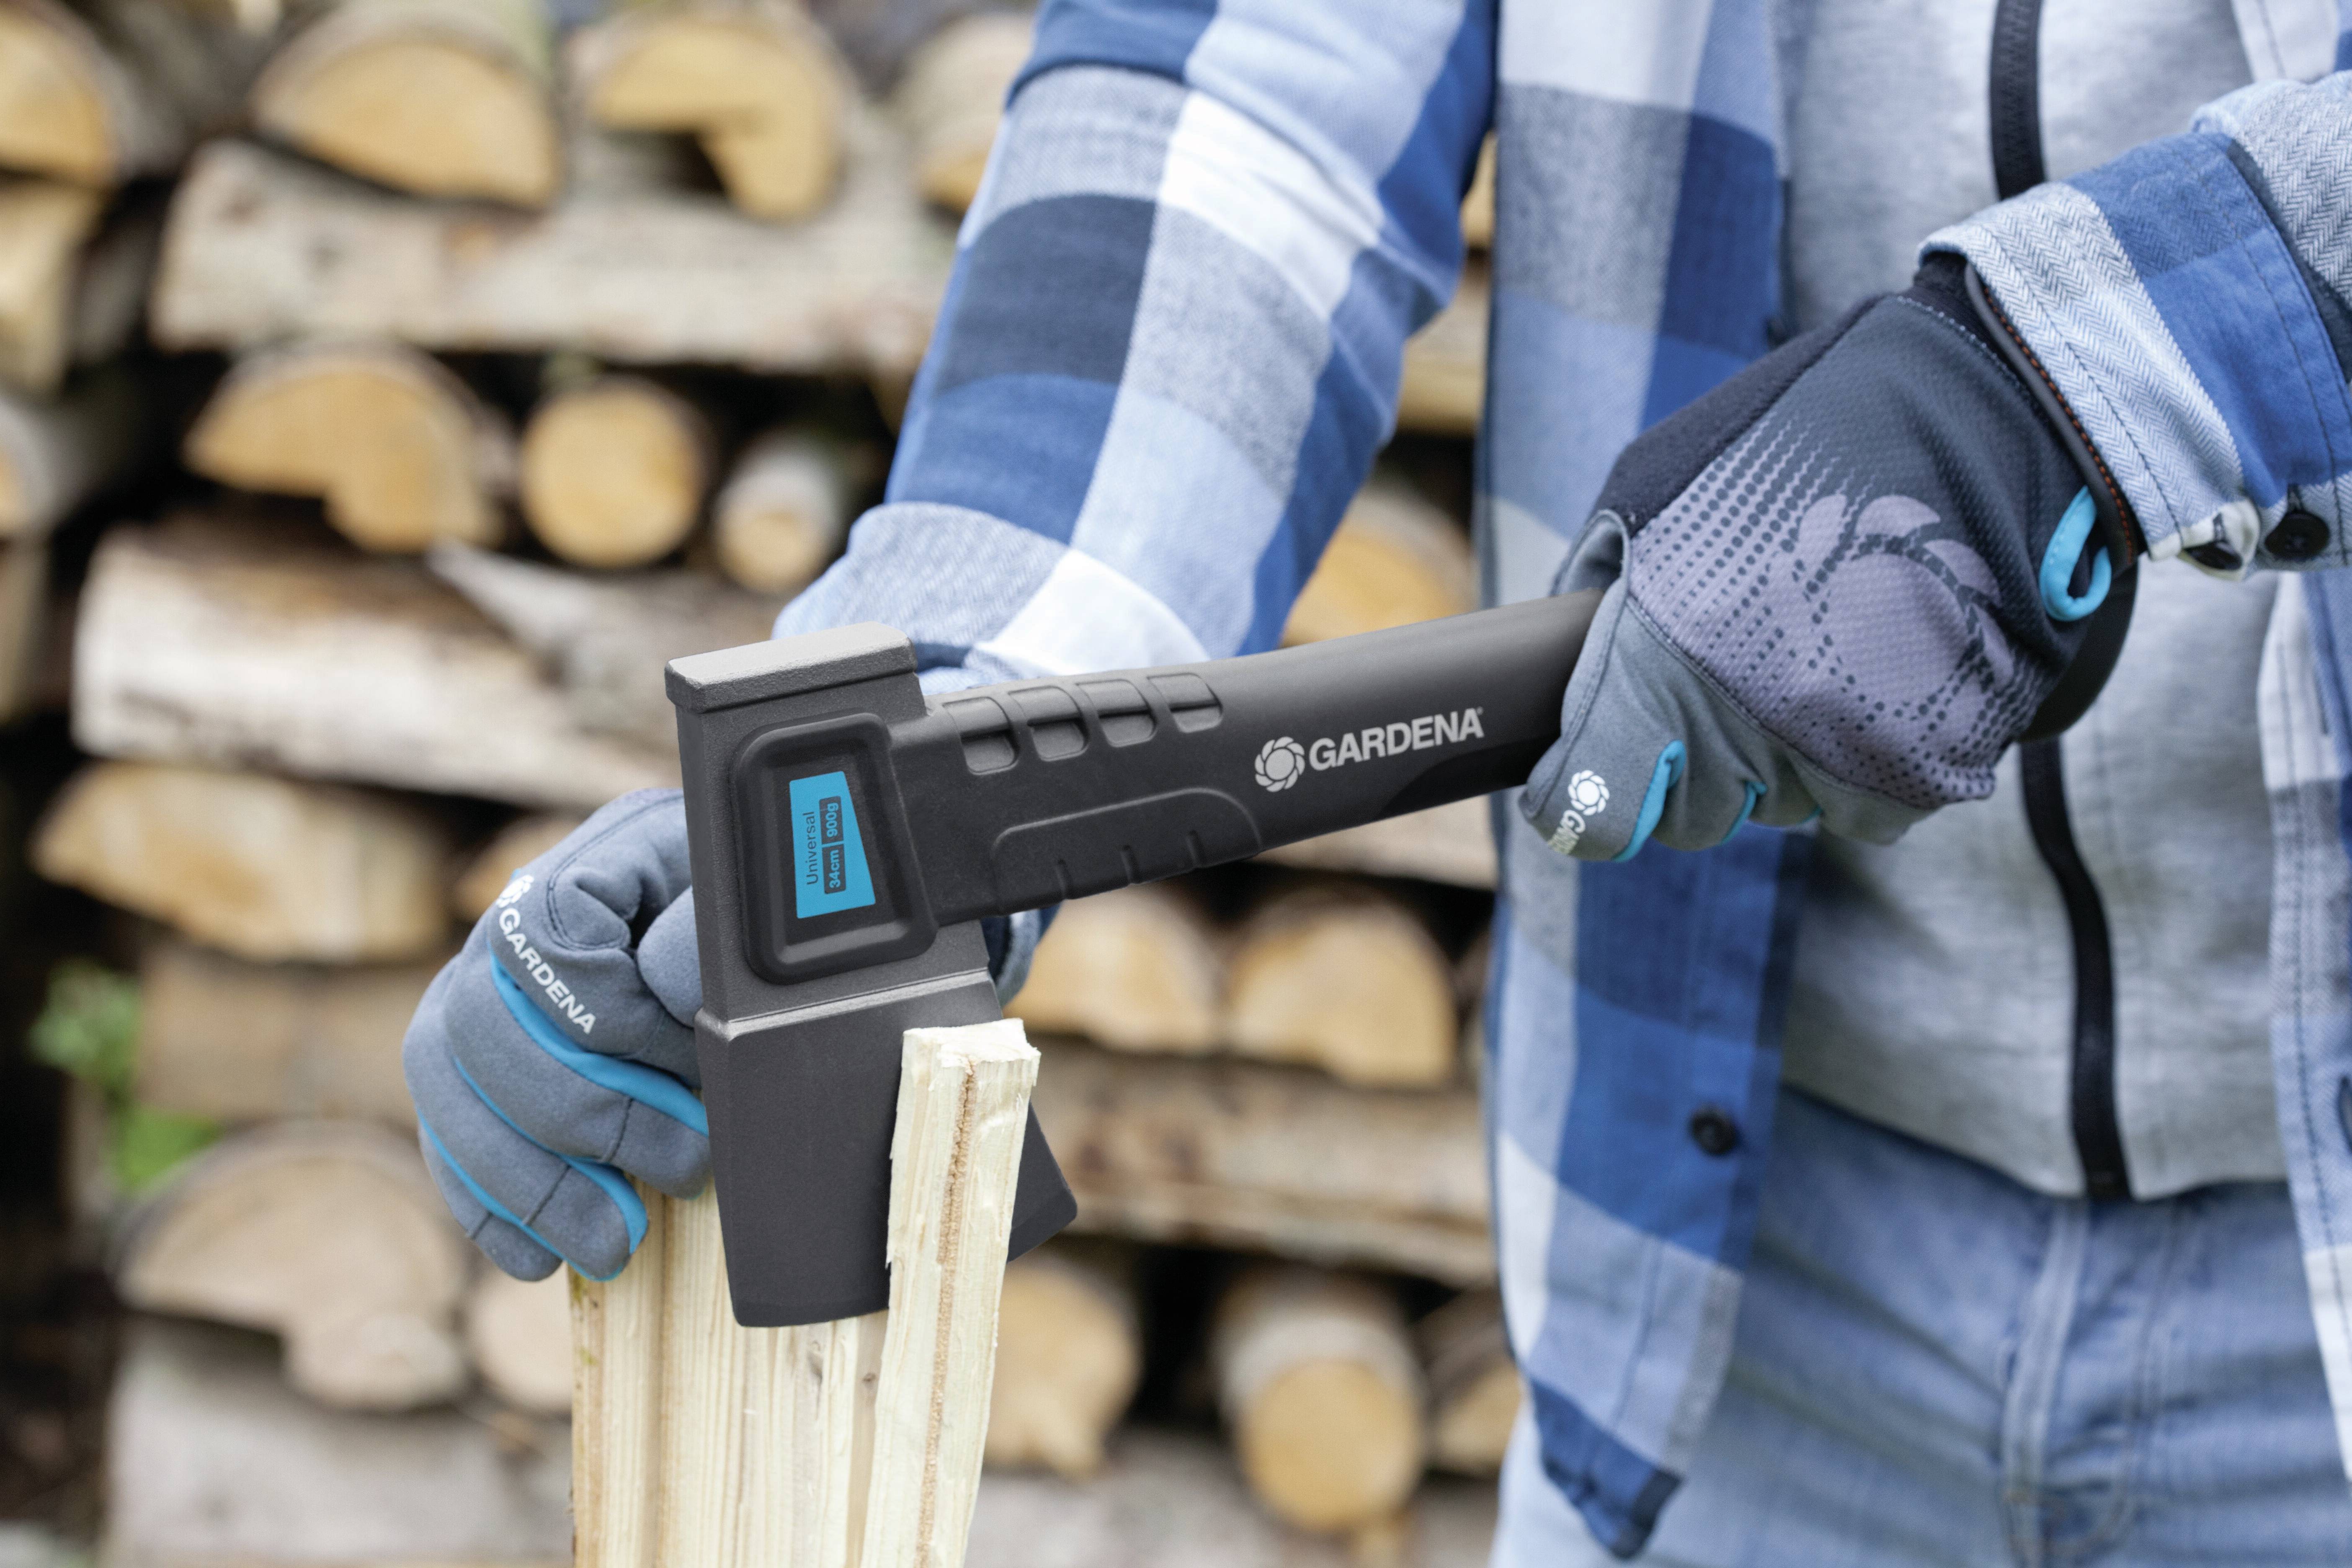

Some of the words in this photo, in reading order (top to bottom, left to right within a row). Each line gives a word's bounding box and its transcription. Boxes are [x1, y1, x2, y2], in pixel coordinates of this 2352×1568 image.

[1309, 707, 1485, 771] GARDENA
[802, 811, 818, 885] Universal
[825, 802, 839, 838] 900g
[828, 849, 841, 889] 34cm
[499, 908, 596, 1034] GARDENA
